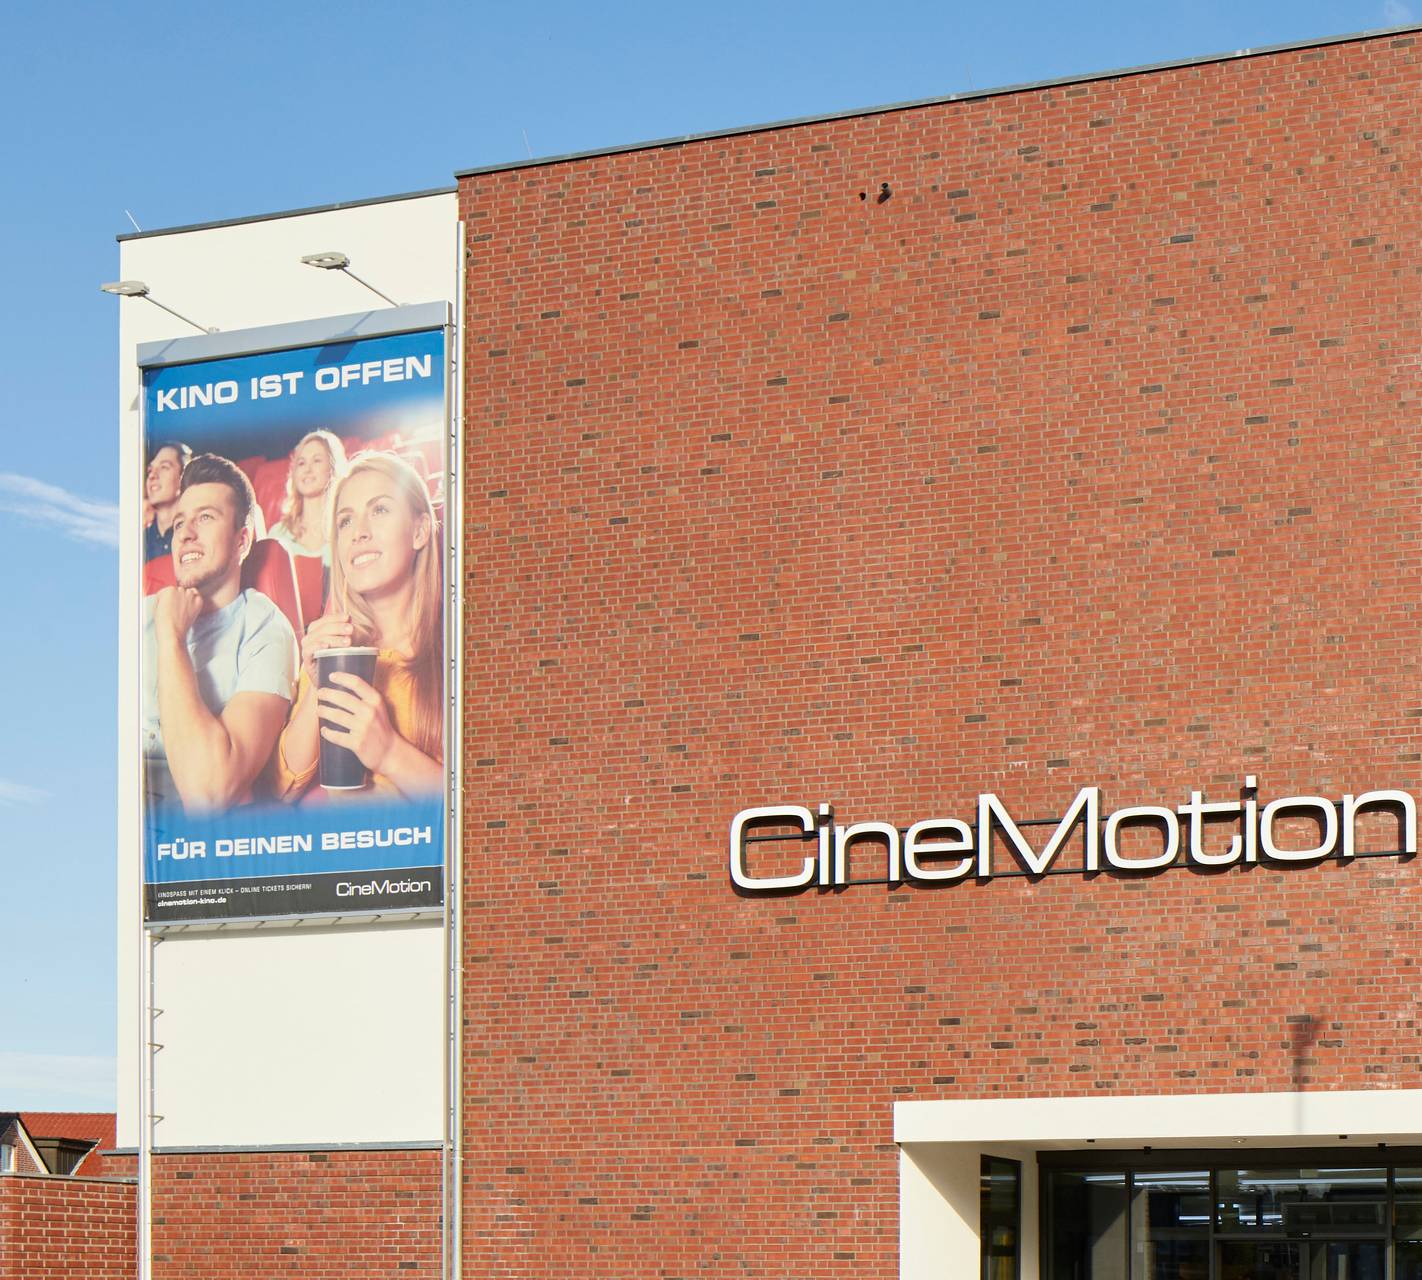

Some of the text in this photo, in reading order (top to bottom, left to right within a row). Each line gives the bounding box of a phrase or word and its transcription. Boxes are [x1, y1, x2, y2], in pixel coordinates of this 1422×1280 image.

[157, 354, 431, 411] KINO IST OFFEN
[158, 826, 431, 861] FÜR DEINEN BESUCH
[729, 776, 1417, 890] CineMotion
[200, 888, 217, 896] EINEM
[218, 887, 234, 895] KLICK
[240, 886, 260, 894] ONLINE
[262, 884, 285, 893] TICKETS
[286, 883, 312, 891] SICHERN!
[336, 878, 431, 897] CineMotion
[157, 897, 227, 907] cinemotion-kino.de
